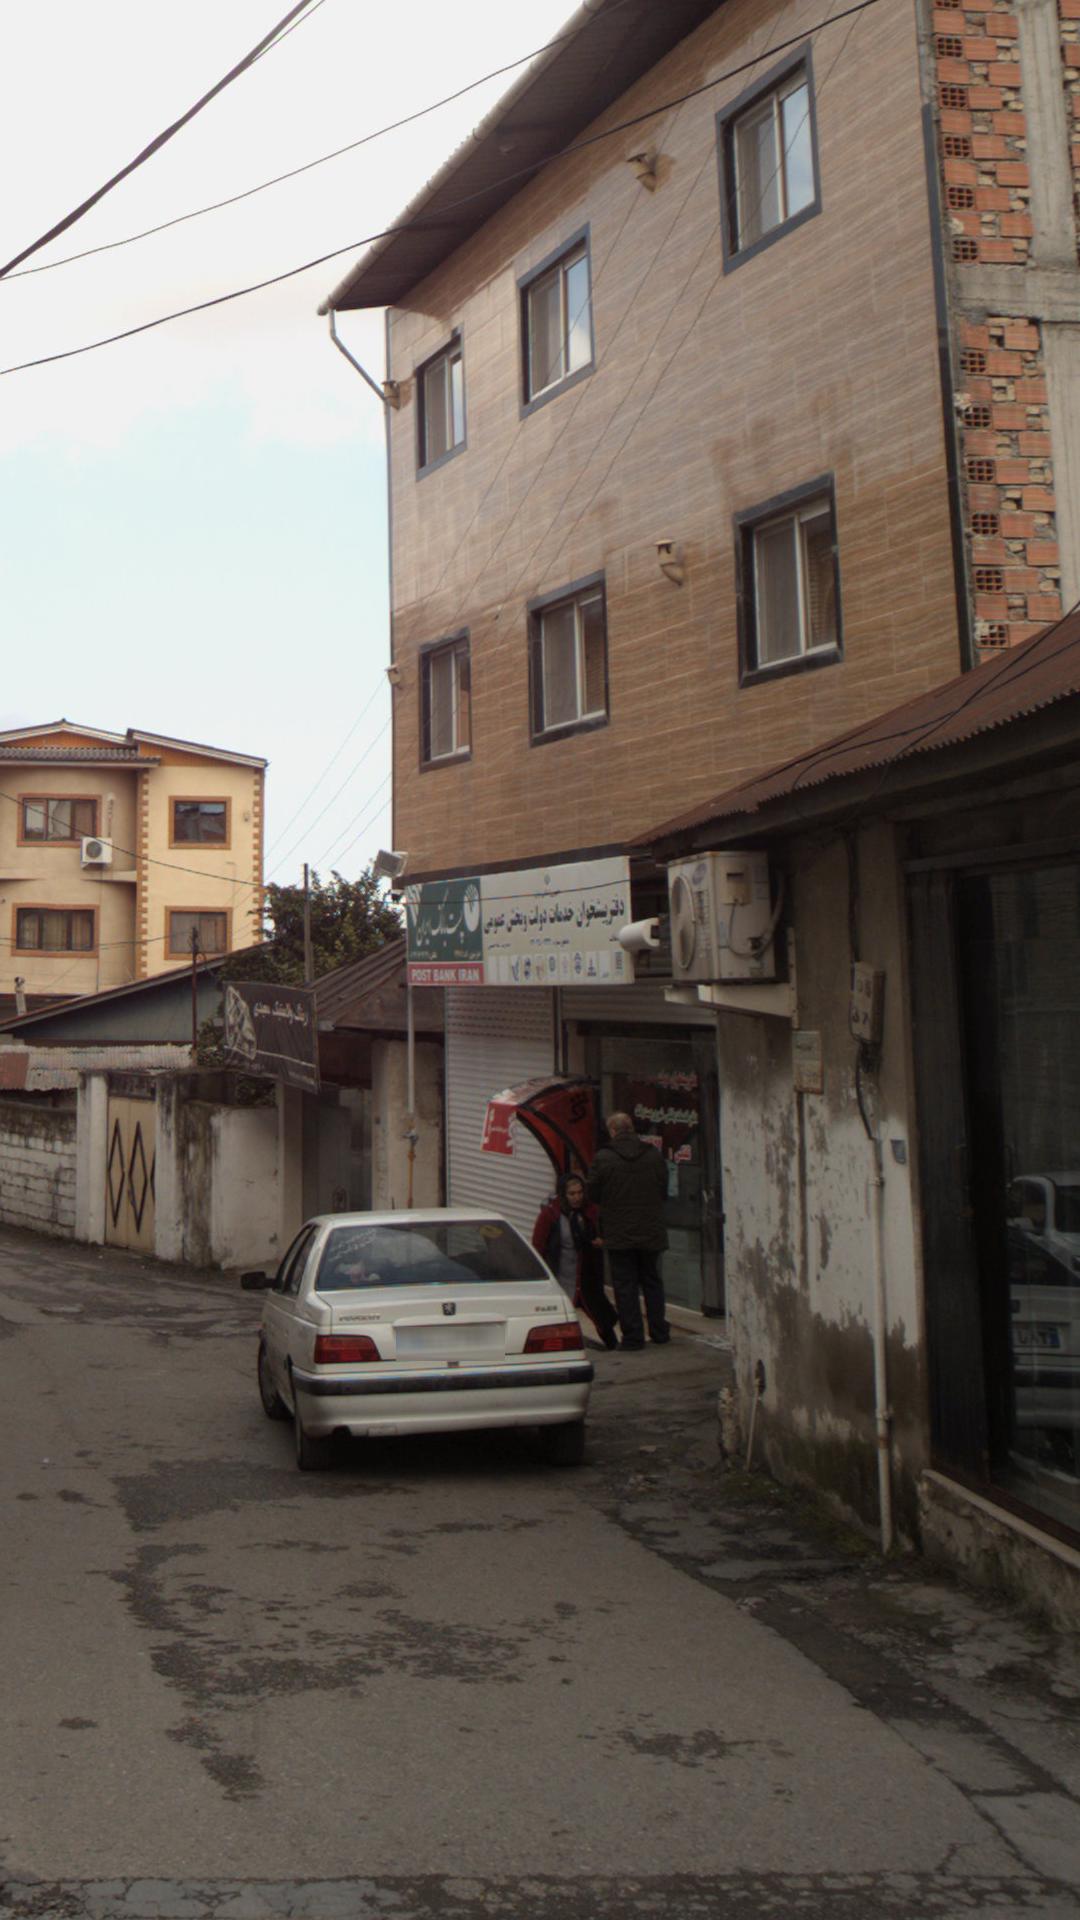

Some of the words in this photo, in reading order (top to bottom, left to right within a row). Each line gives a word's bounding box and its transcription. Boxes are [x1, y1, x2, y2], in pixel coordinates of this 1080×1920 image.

[528, 904, 547, 931] دولت
[549, 902, 574, 924] خدمات
[576, 899, 608, 928] پیشخوان
[608, 894, 625, 926] دفتر
[411, 969, 432, 982] POST
[433, 968, 457, 981] BANK
[458, 967, 480, 981] IRAN
